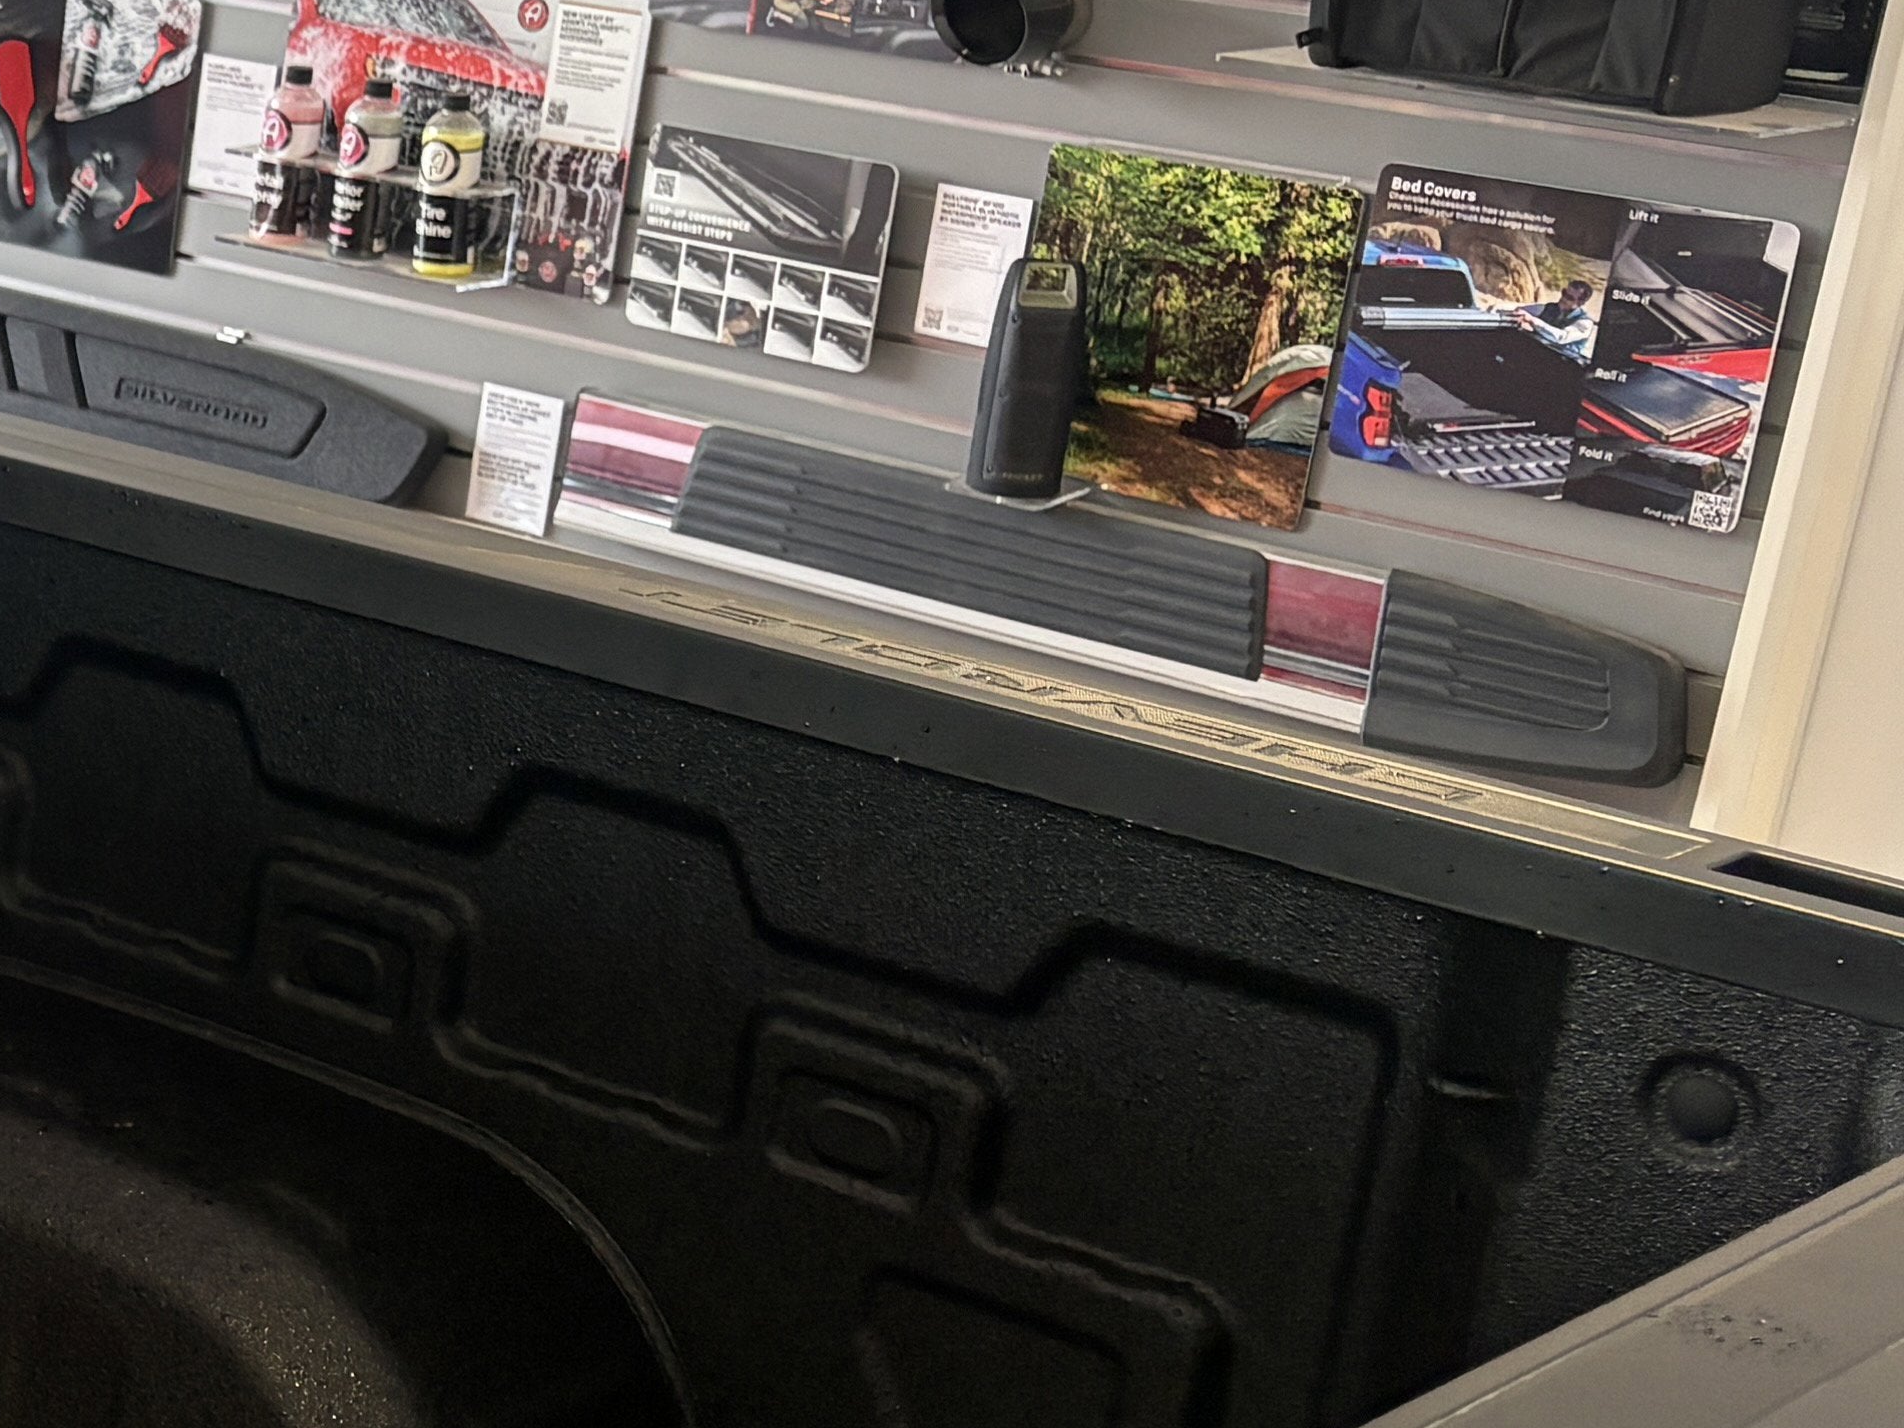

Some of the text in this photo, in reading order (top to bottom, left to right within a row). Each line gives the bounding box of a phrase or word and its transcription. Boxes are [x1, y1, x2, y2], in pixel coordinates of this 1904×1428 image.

[1390, 176, 1477, 202] Bed Covers
[1389, 191, 1429, 204] Chevrolet
[1431, 197, 1480, 213] Accessories
[1506, 209, 1541, 222] solution
[1542, 214, 1555, 224] for
[648, 203, 751, 233] STEP-UP CONVENIENCE
[1480, 215, 1497, 225] bed
[1629, 209, 1660, 224] Lift it
[646, 215, 733, 242] WITH ASSIST STEPS
[1612, 289, 1651, 306] Slide it
[1594, 367, 1628, 383] Roll it
[1578, 446, 1613, 462] Fold it
